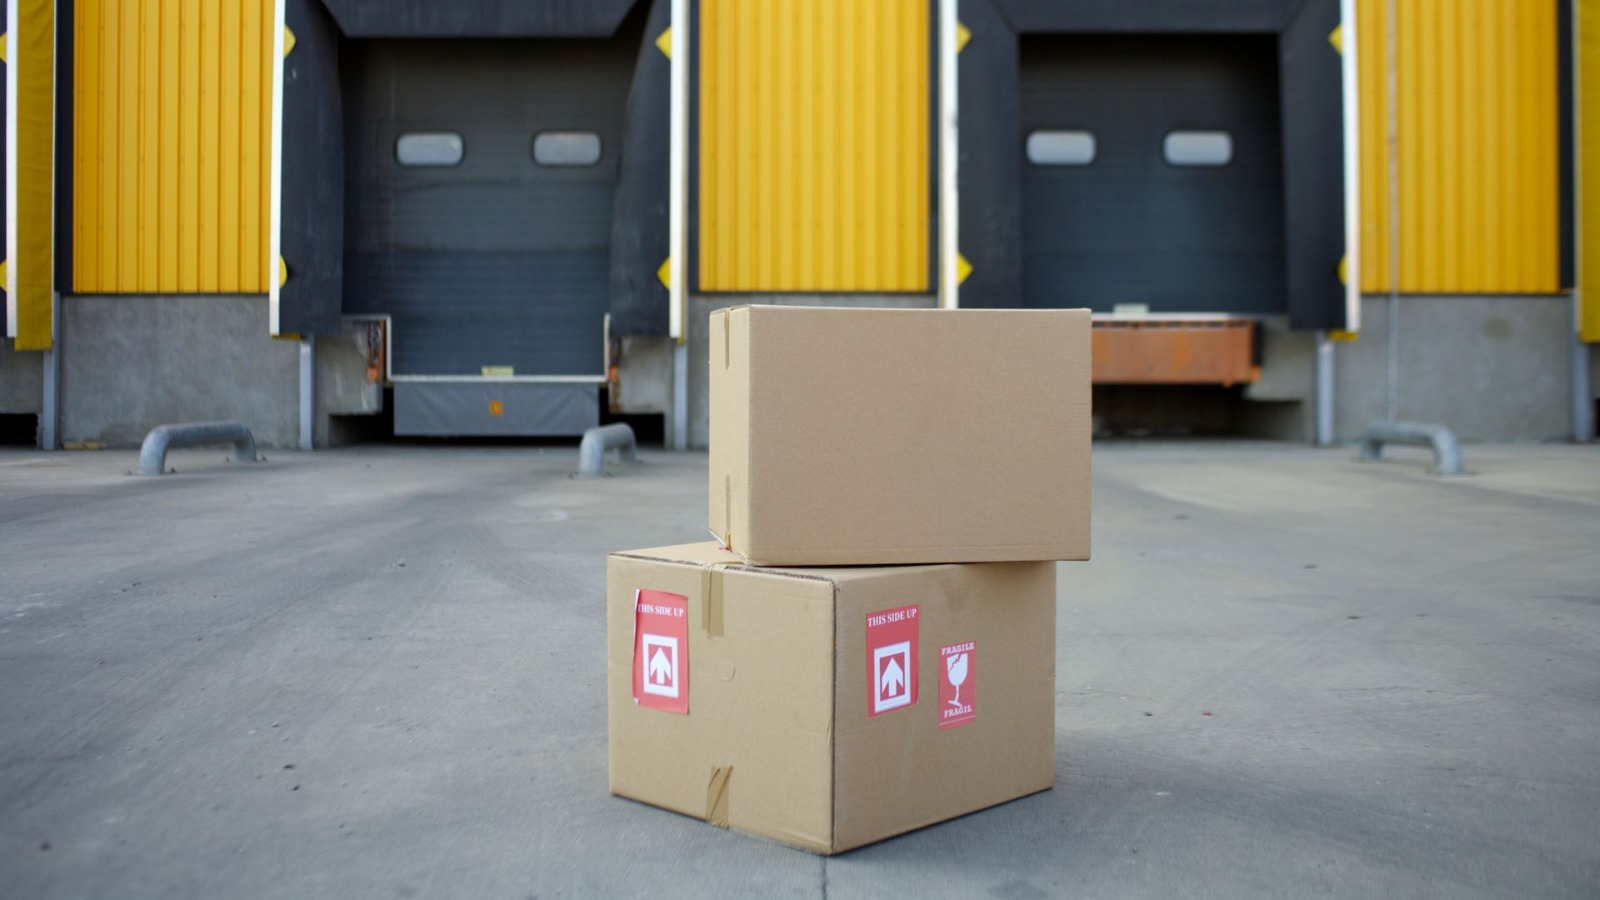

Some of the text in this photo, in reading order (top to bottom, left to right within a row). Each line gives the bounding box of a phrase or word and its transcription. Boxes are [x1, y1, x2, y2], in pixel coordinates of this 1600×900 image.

[654, 606, 672, 616] SIDE
[674, 608, 684, 618] UP
[868, 608, 917, 627] THIS SIDE UP
[941, 642, 974, 656] FRAGILE
